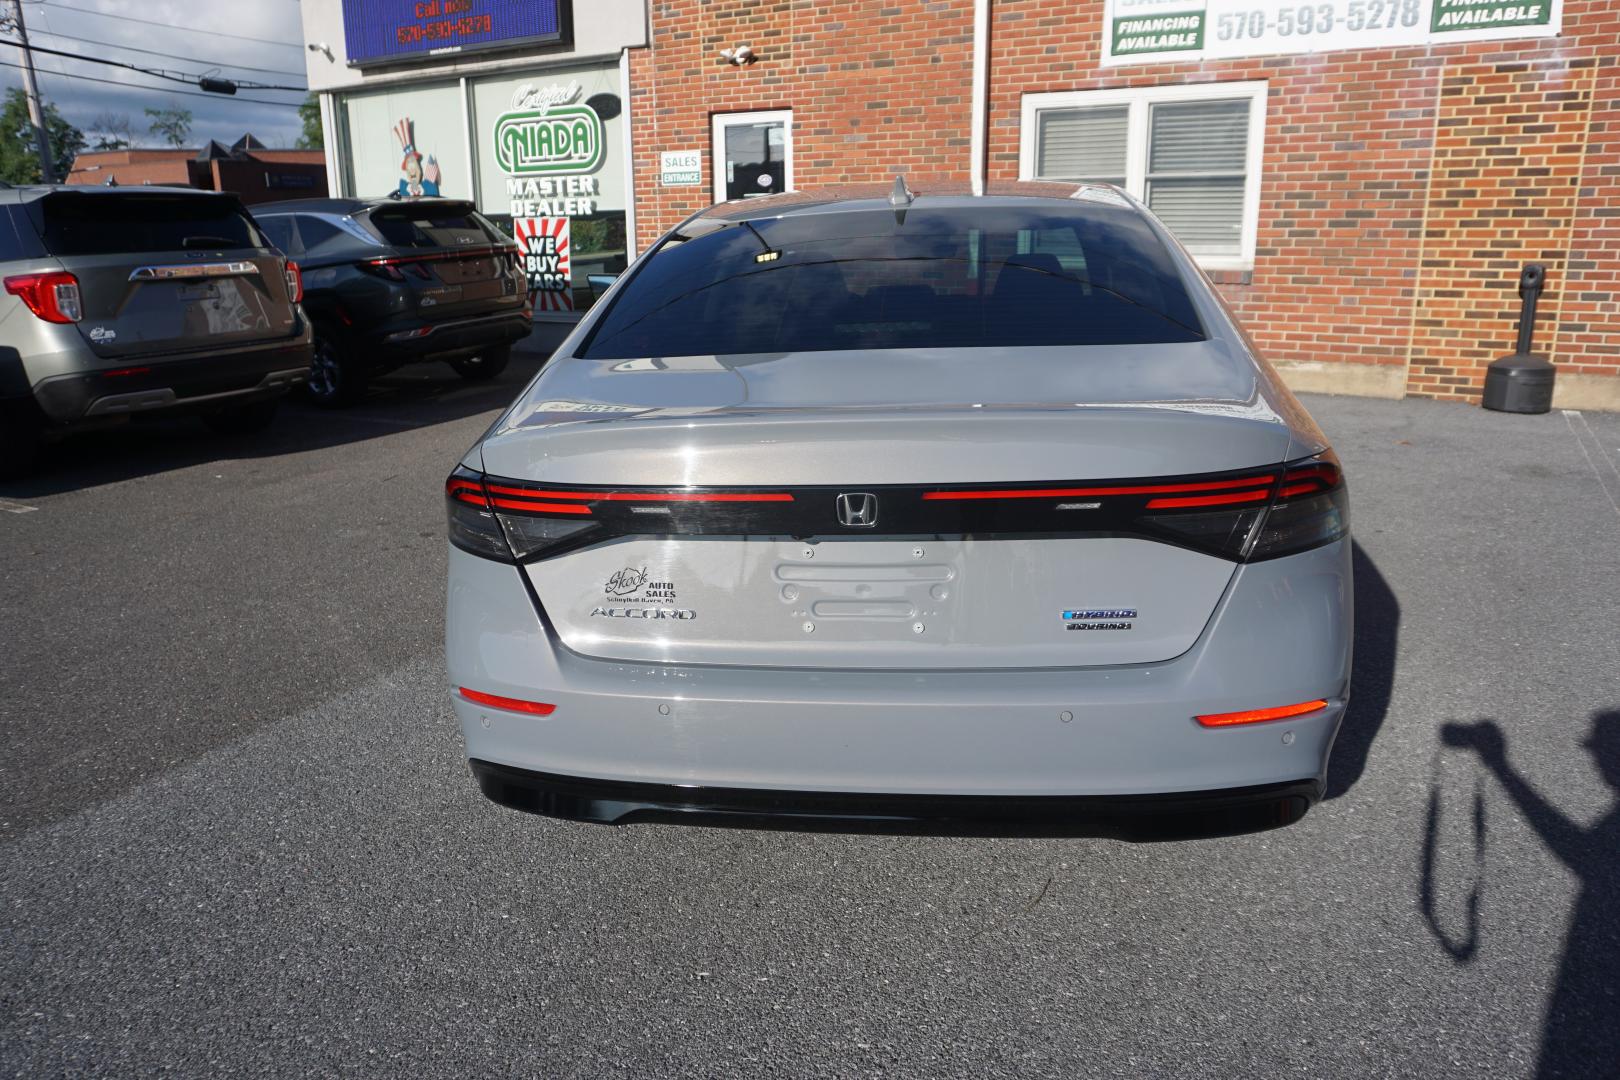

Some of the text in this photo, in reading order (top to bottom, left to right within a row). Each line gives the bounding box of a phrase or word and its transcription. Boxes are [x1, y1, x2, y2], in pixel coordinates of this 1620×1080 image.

[415, 0, 441, 19] Call
[1438, 5, 1541, 26] AVAILABLE
[1117, 16, 1200, 35] FINANCING
[1217, 0, 1421, 41] 570-593-5278
[1116, 32, 1198, 51] AVAILABLE
[503, 118, 590, 161] NIADA
[665, 156, 698, 168] SALES
[506, 175, 594, 195] MASTER
[664, 172, 699, 183] ENTRANCE
[510, 197, 593, 217] DEALER
[527, 237, 555, 255] WE
[526, 255, 559, 273] BUY
[646, 590, 676, 598] SALES
[648, 582, 674, 590] AUTO
[590, 607, 697, 620] ACCORD
